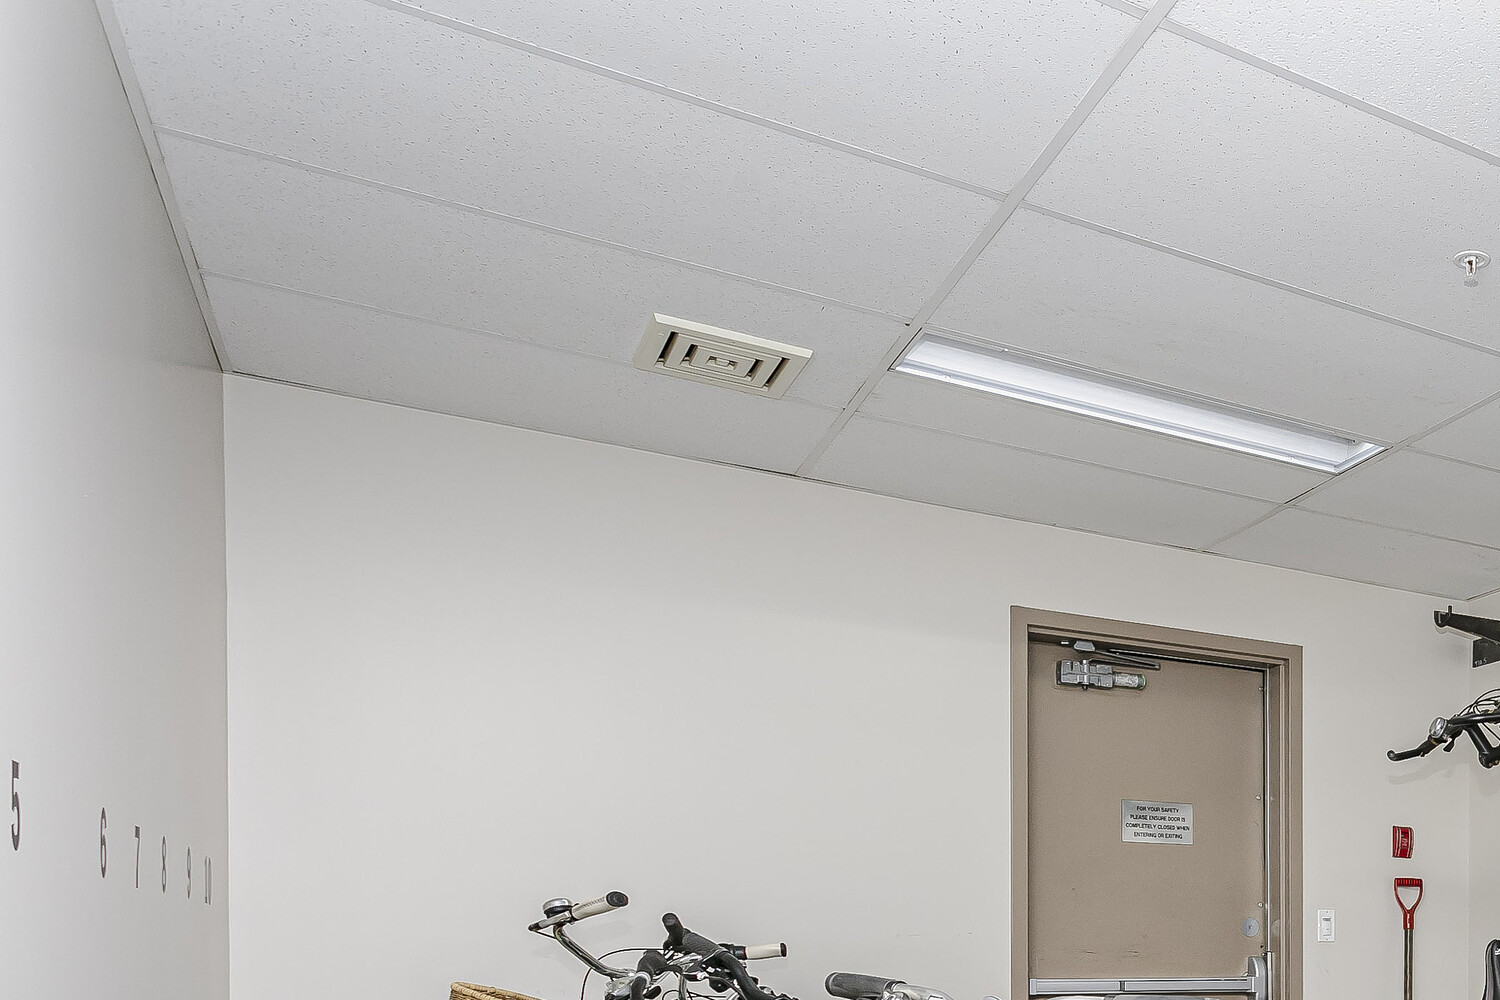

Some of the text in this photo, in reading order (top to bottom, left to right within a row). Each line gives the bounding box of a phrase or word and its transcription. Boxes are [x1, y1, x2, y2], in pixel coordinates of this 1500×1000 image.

[11, 760, 20, 851] 5
[100, 806, 107, 879] 6
[134, 825, 141, 888] 7
[161, 835, 167, 894] 8
[186, 846, 192, 900] 9
[204, 856, 212, 906] 10
